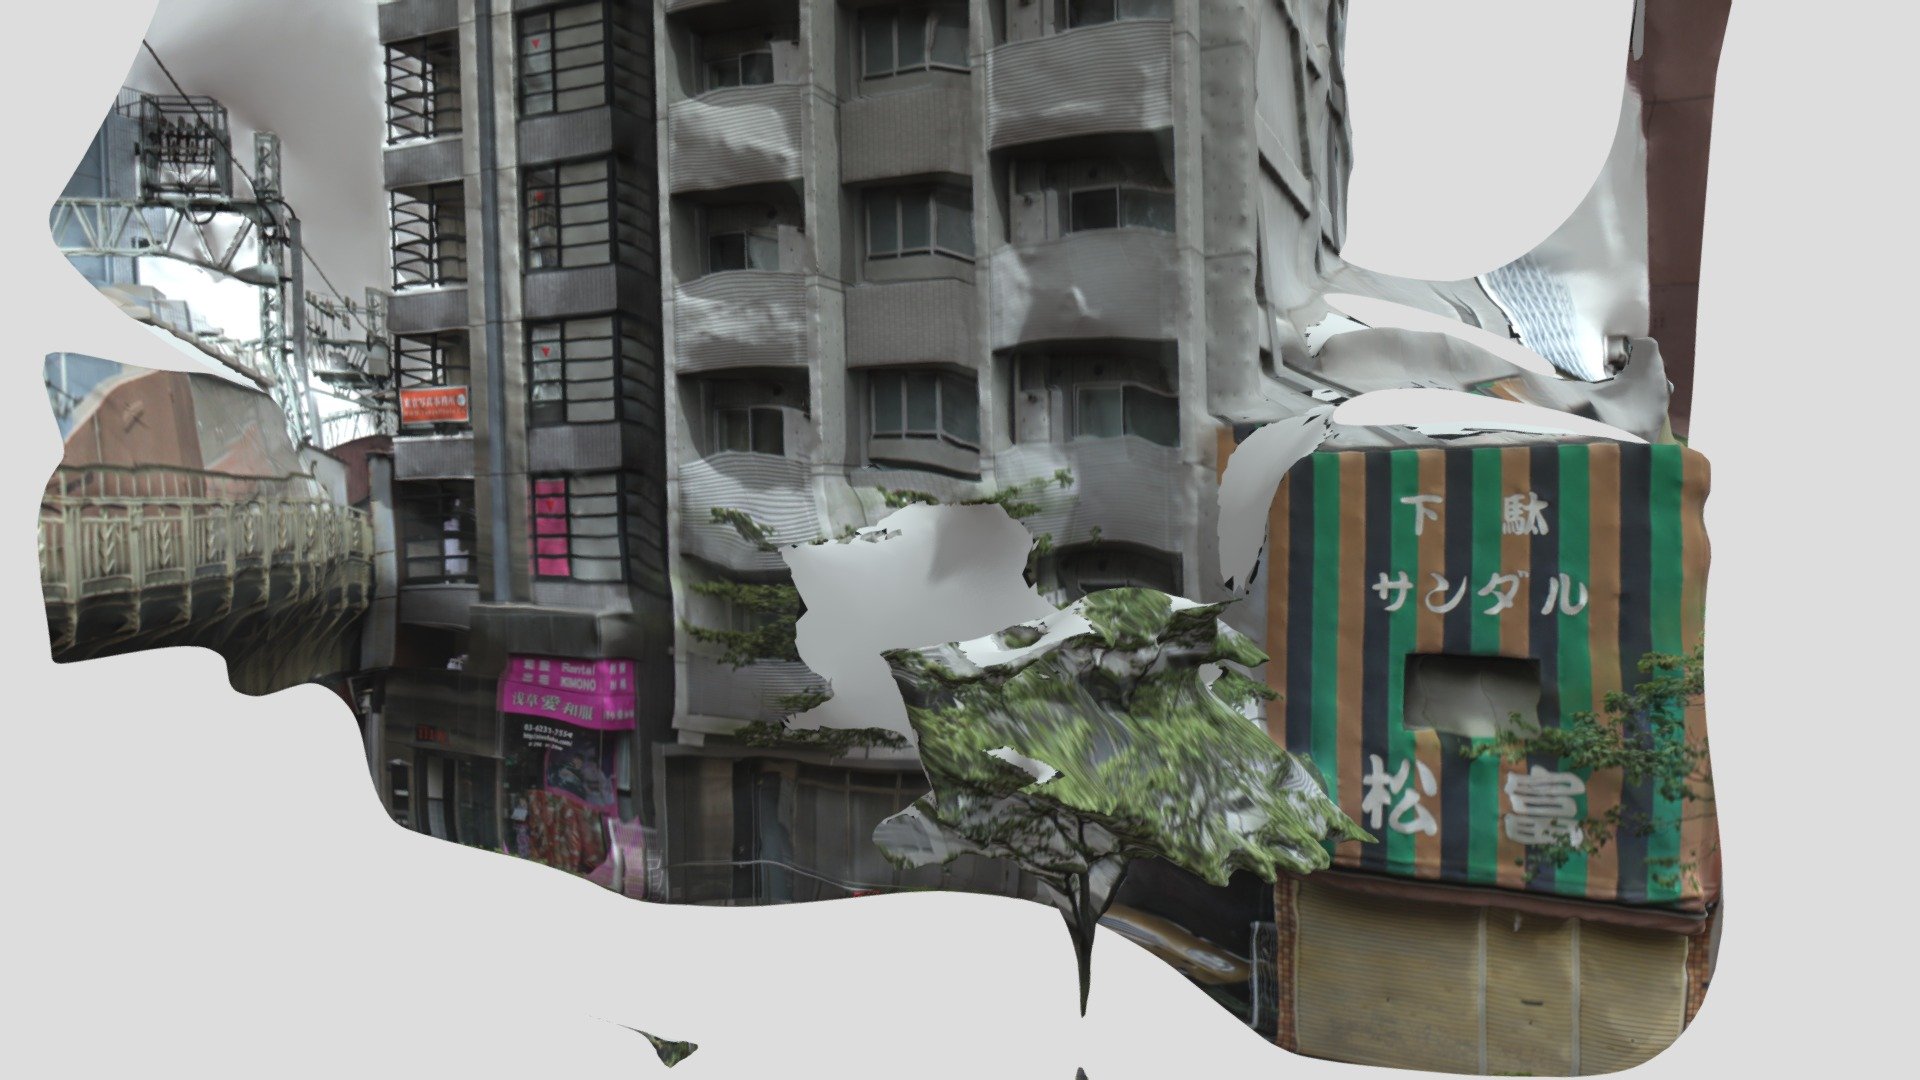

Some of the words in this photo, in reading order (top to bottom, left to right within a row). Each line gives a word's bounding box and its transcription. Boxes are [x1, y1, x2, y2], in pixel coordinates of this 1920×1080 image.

[1400, 491, 1550, 537] 下駄
[1371, 569, 1588, 616] サンダル
[560, 675, 597, 692] KIMONO
[561, 662, 596, 676] Rental
[1361, 753, 1586, 848] 松富
